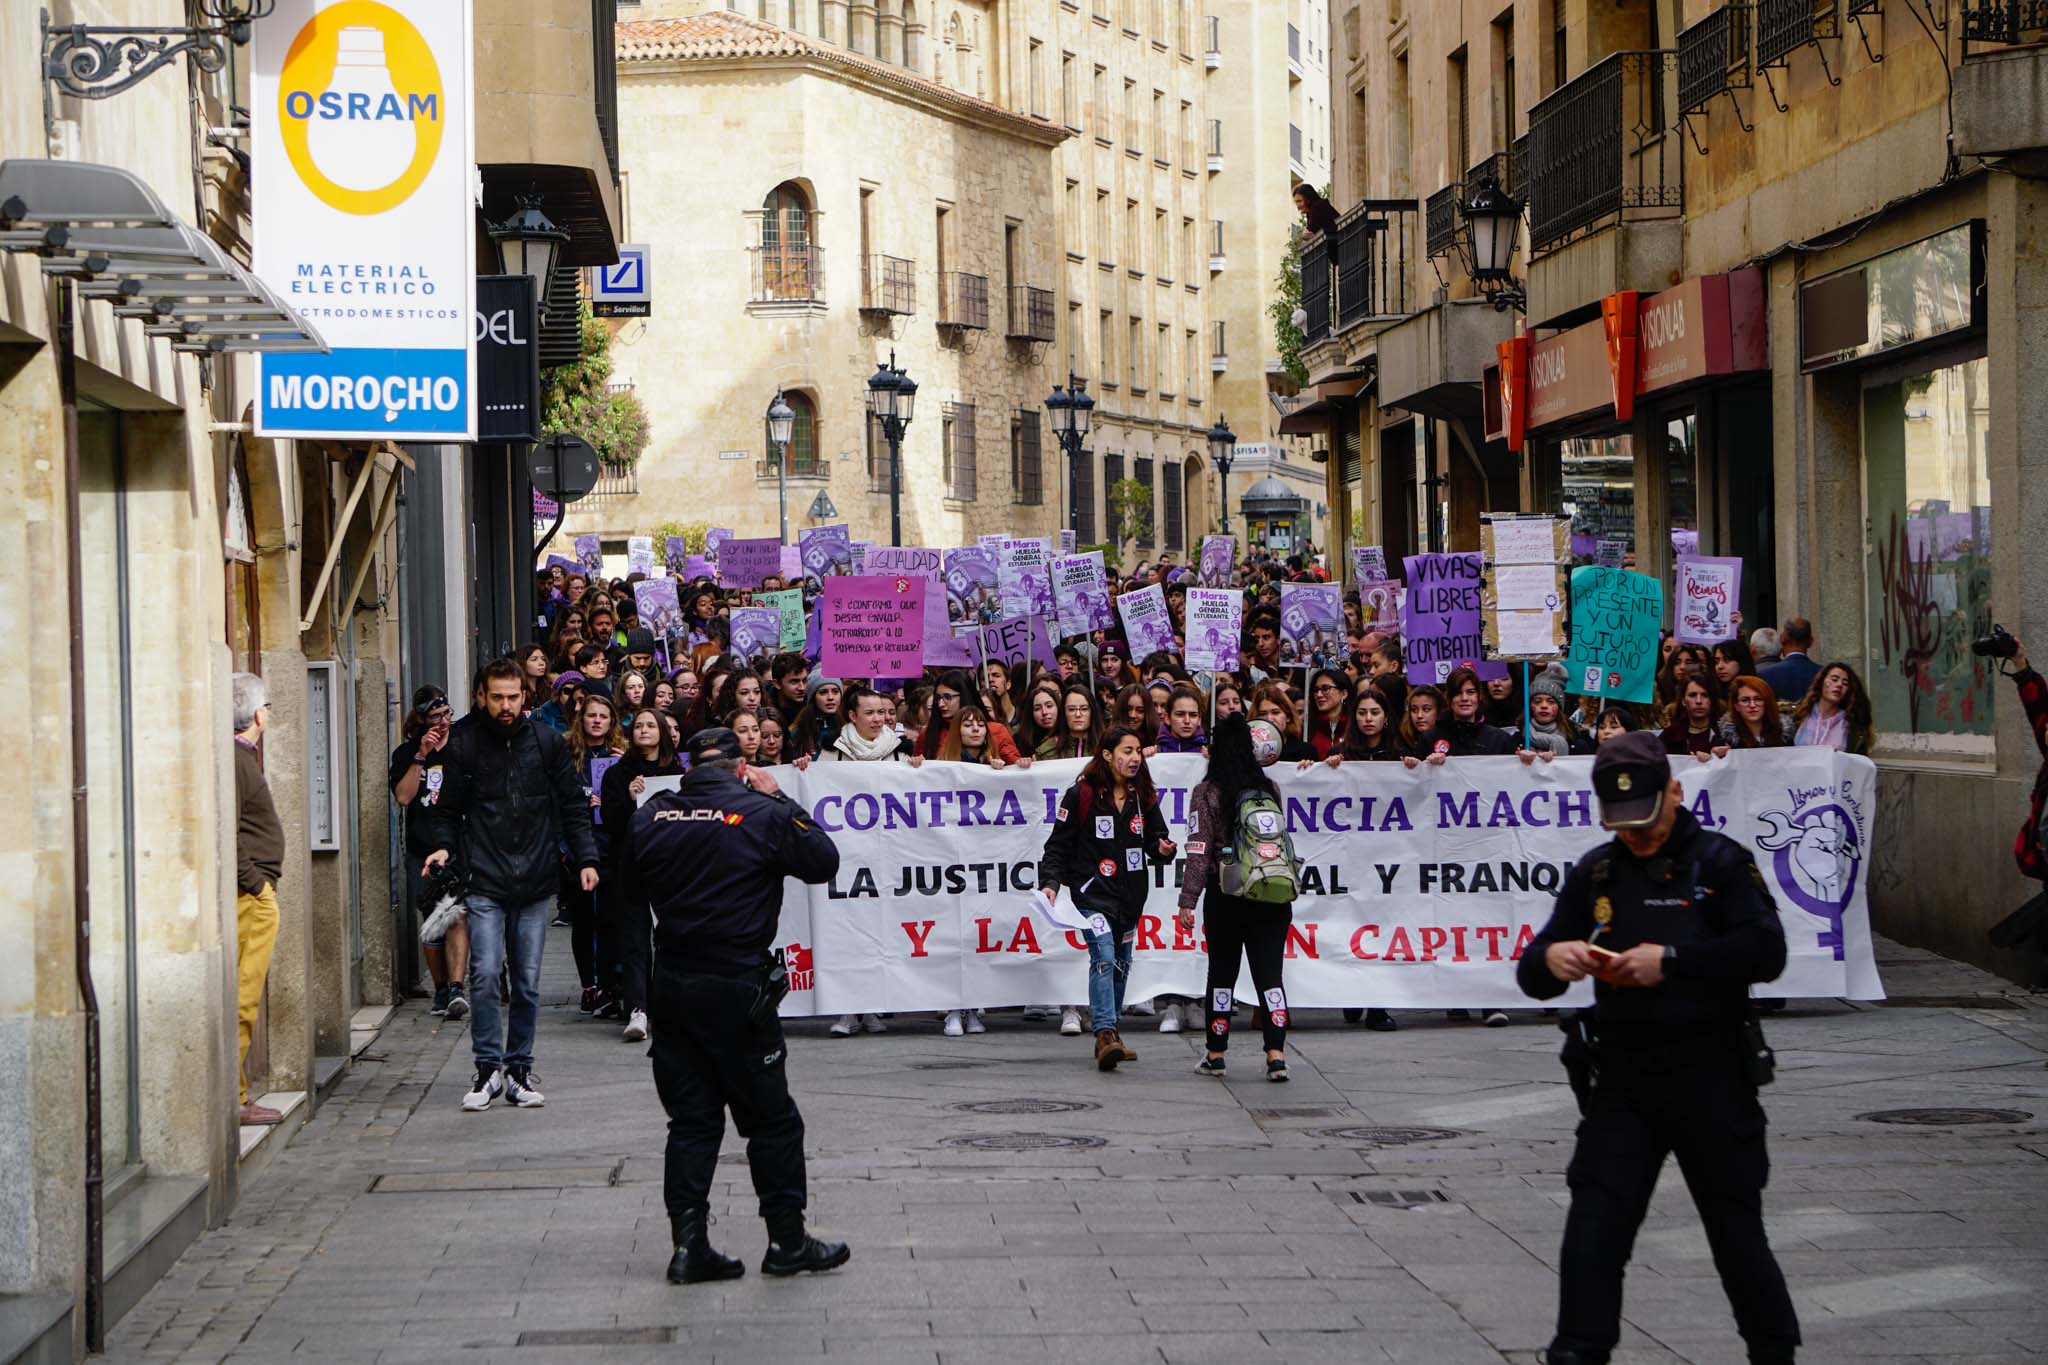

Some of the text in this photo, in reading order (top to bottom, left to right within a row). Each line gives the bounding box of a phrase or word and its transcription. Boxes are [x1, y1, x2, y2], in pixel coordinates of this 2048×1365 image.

[286, 91, 438, 121] OSRAM
[298, 264, 428, 278] MATERIAL
[291, 281, 435, 295] ELECTRICO
[293, 308, 458, 319] CTRODOMESTICOS
[1640, 299, 1685, 352] VISIONLAB
[1528, 345, 1566, 391] VISIONLAB
[1004, 541, 1040, 549] 8 Marzo
[809, 550, 825, 569] 8
[867, 551, 940, 571] IGUALDAD
[1055, 558, 1092, 569] 8 Marzo
[1067, 565, 1093, 574] HUELGA
[1415, 555, 1481, 583] VIVAS
[950, 571, 968, 591] 8
[1064, 571, 1095, 580] GENERAL
[1590, 567, 1658, 596] POR UN
[1120, 590, 1152, 606] 8 Marzo
[1191, 590, 1229, 600] 8 Marzo
[1574, 585, 1661, 618] PRESENTE
[1686, 577, 1727, 605] Reinas
[1286, 610, 1305, 631] 8
[1440, 616, 1452, 634] Y
[1587, 609, 1633, 631] Y UN
[975, 628, 999, 657] NO
[1000, 620, 1036, 651] ES
[1571, 624, 1651, 654] FUTURO
[890, 660, 902, 670] NO
[1575, 644, 1640, 671] DIGNO
[654, 809, 725, 822] POLICIA
[813, 788, 1027, 832] CONTRA
[827, 868, 880, 899] LA
[1375, 863, 1400, 894] Y
[901, 920, 936, 957] Y
[975, 916, 1042, 954] LA
